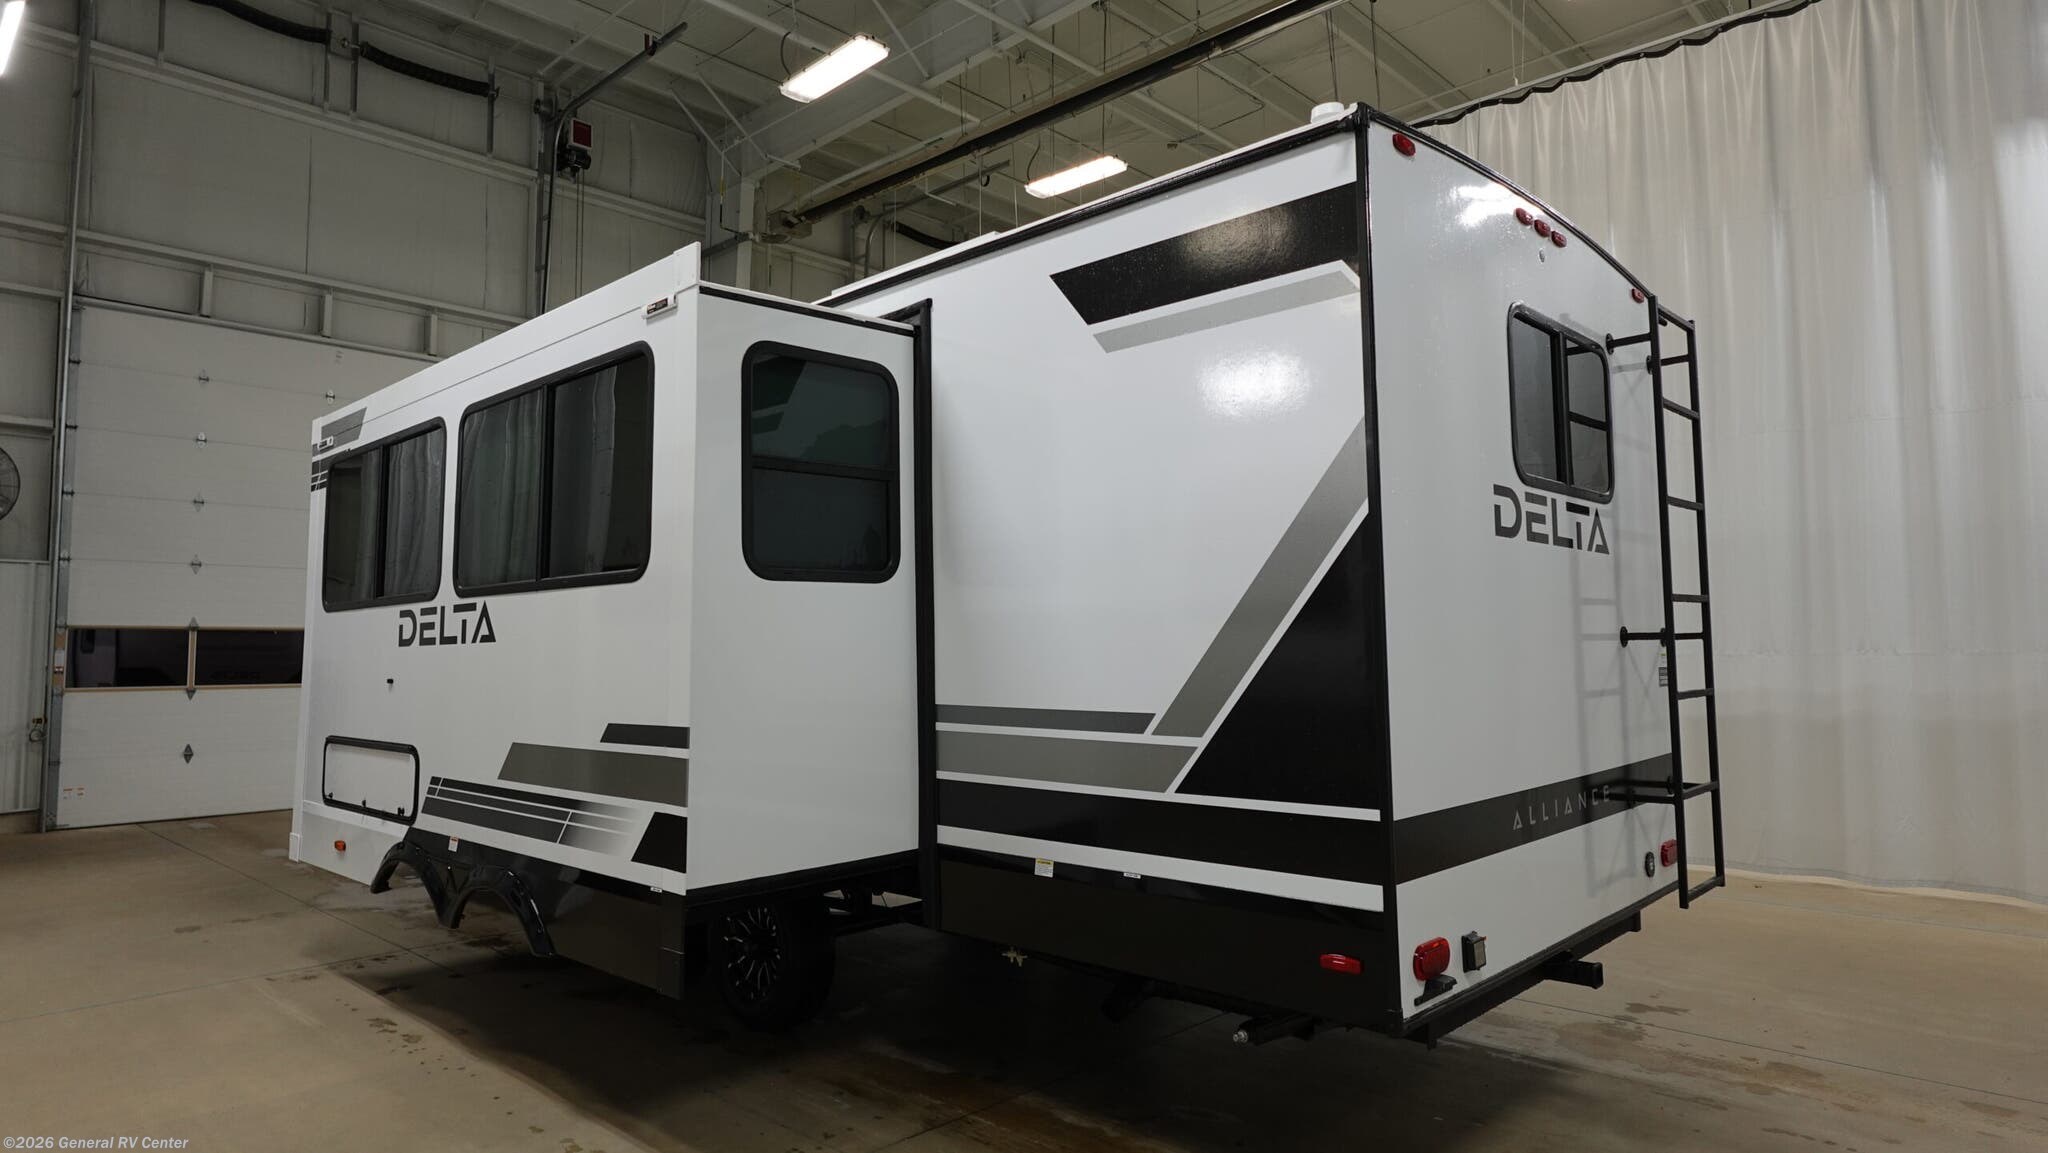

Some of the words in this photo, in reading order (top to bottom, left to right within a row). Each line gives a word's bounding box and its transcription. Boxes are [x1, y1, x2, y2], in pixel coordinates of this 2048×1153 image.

[1493, 484, 1610, 555] DELTA
[398, 600, 496, 647] DELTA
[1513, 785, 1610, 830] ALLIANCE
